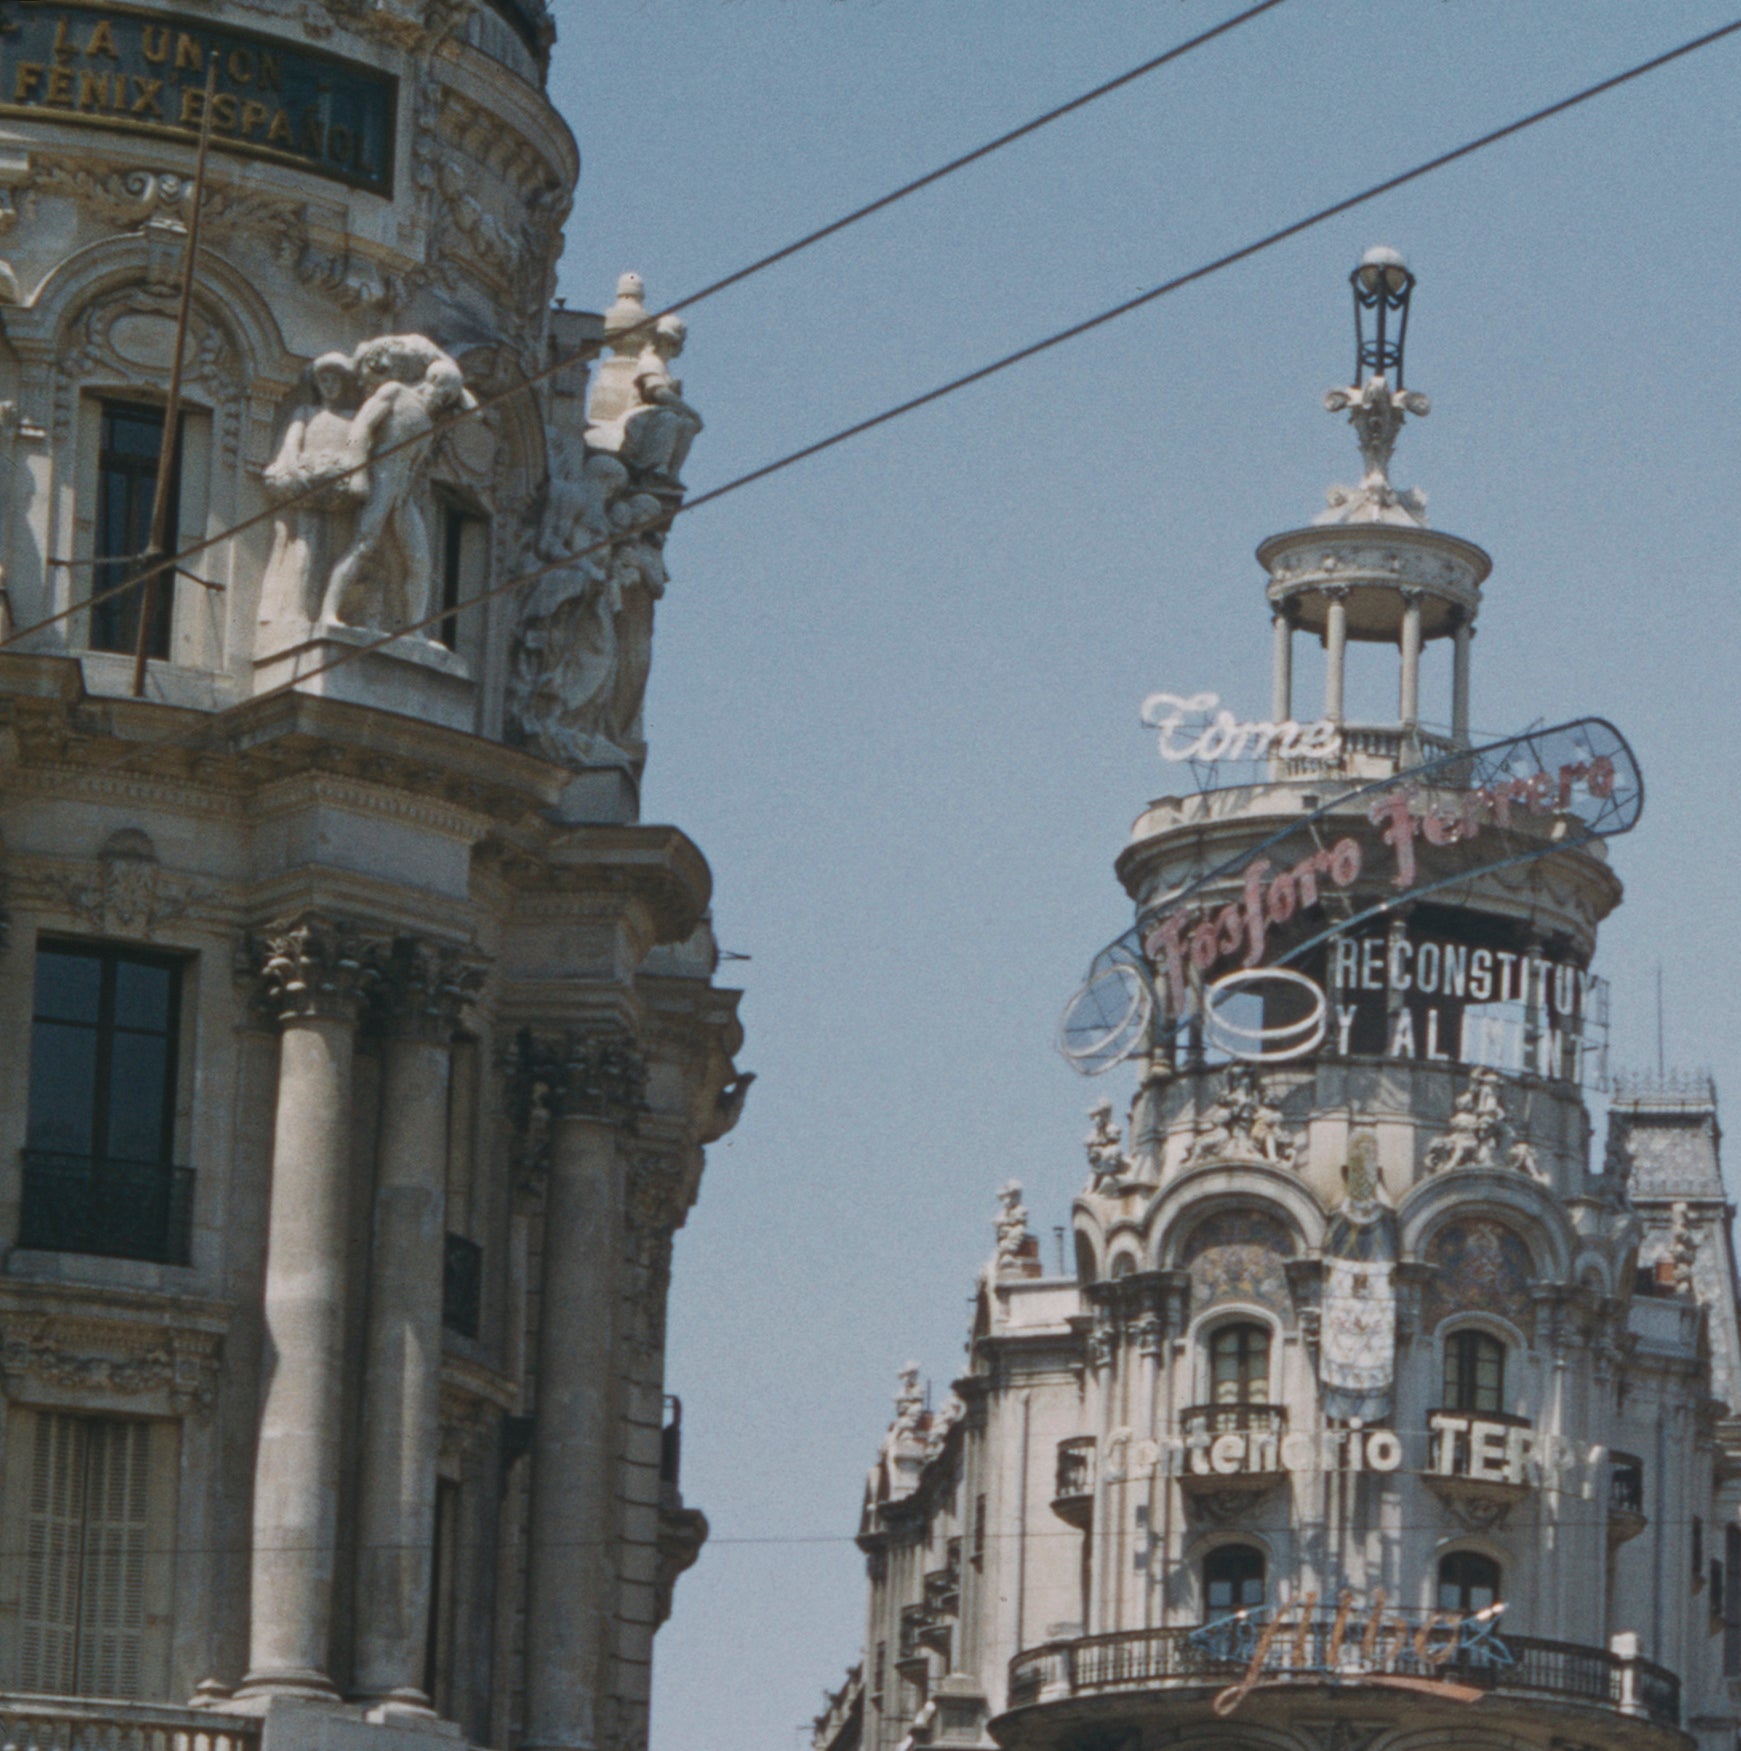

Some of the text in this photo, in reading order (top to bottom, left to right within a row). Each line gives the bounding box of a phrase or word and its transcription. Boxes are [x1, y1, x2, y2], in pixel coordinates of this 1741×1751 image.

[54, 16, 282, 92] LA UNON
[1141, 692, 1342, 762] Tome
[1368, 755, 1615, 887] Ferrero
[1336, 1003, 1357, 1056] Y
[1103, 1416, 1403, 1484] Centenario
